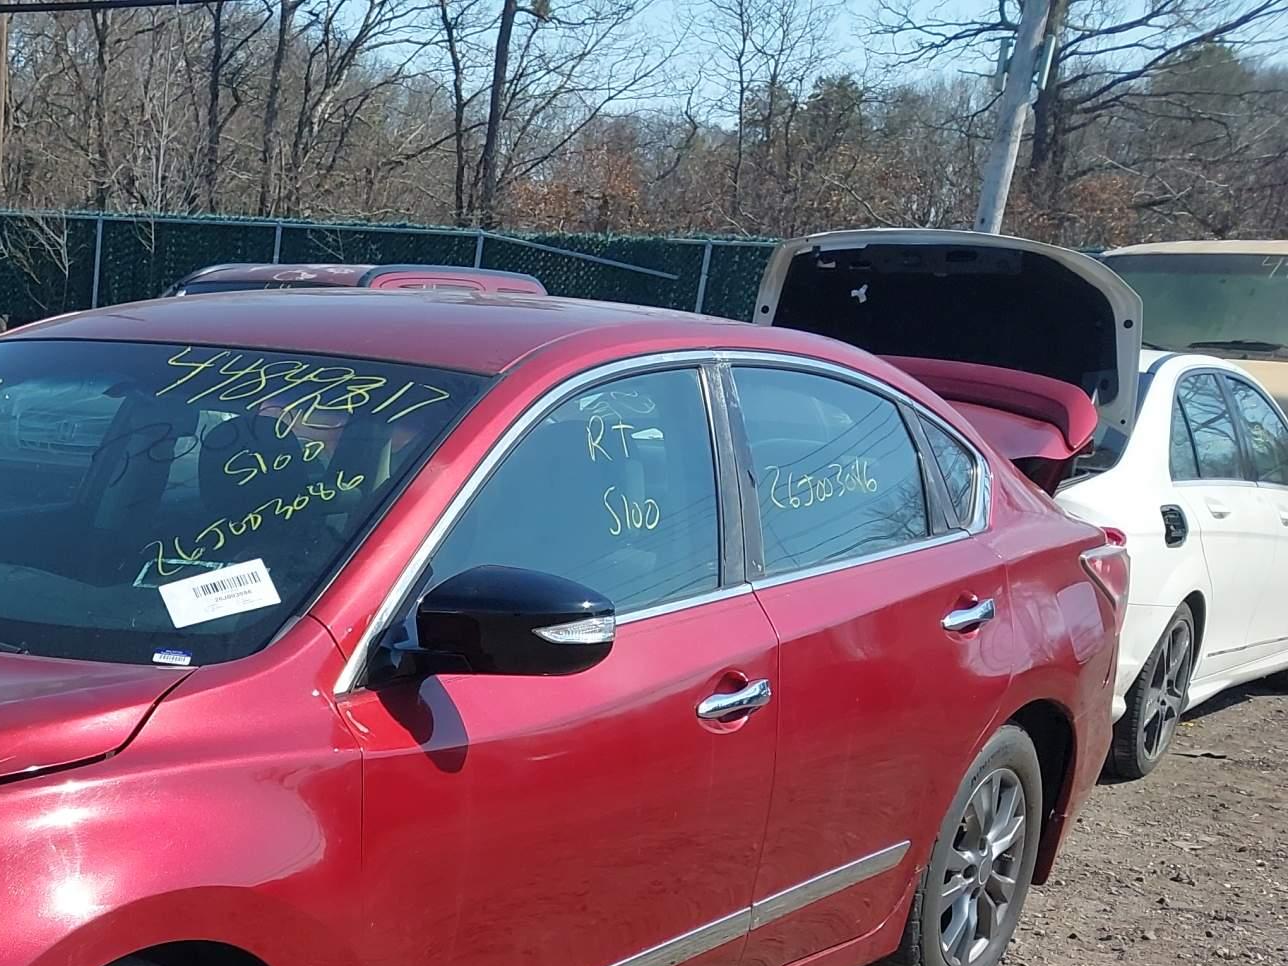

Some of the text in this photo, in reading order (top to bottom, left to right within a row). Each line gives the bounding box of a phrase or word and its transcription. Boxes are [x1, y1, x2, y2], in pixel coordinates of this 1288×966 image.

[155, 345, 450, 423] 44849317
[224, 441, 325, 486] S100
[603, 486, 660, 535] S100
